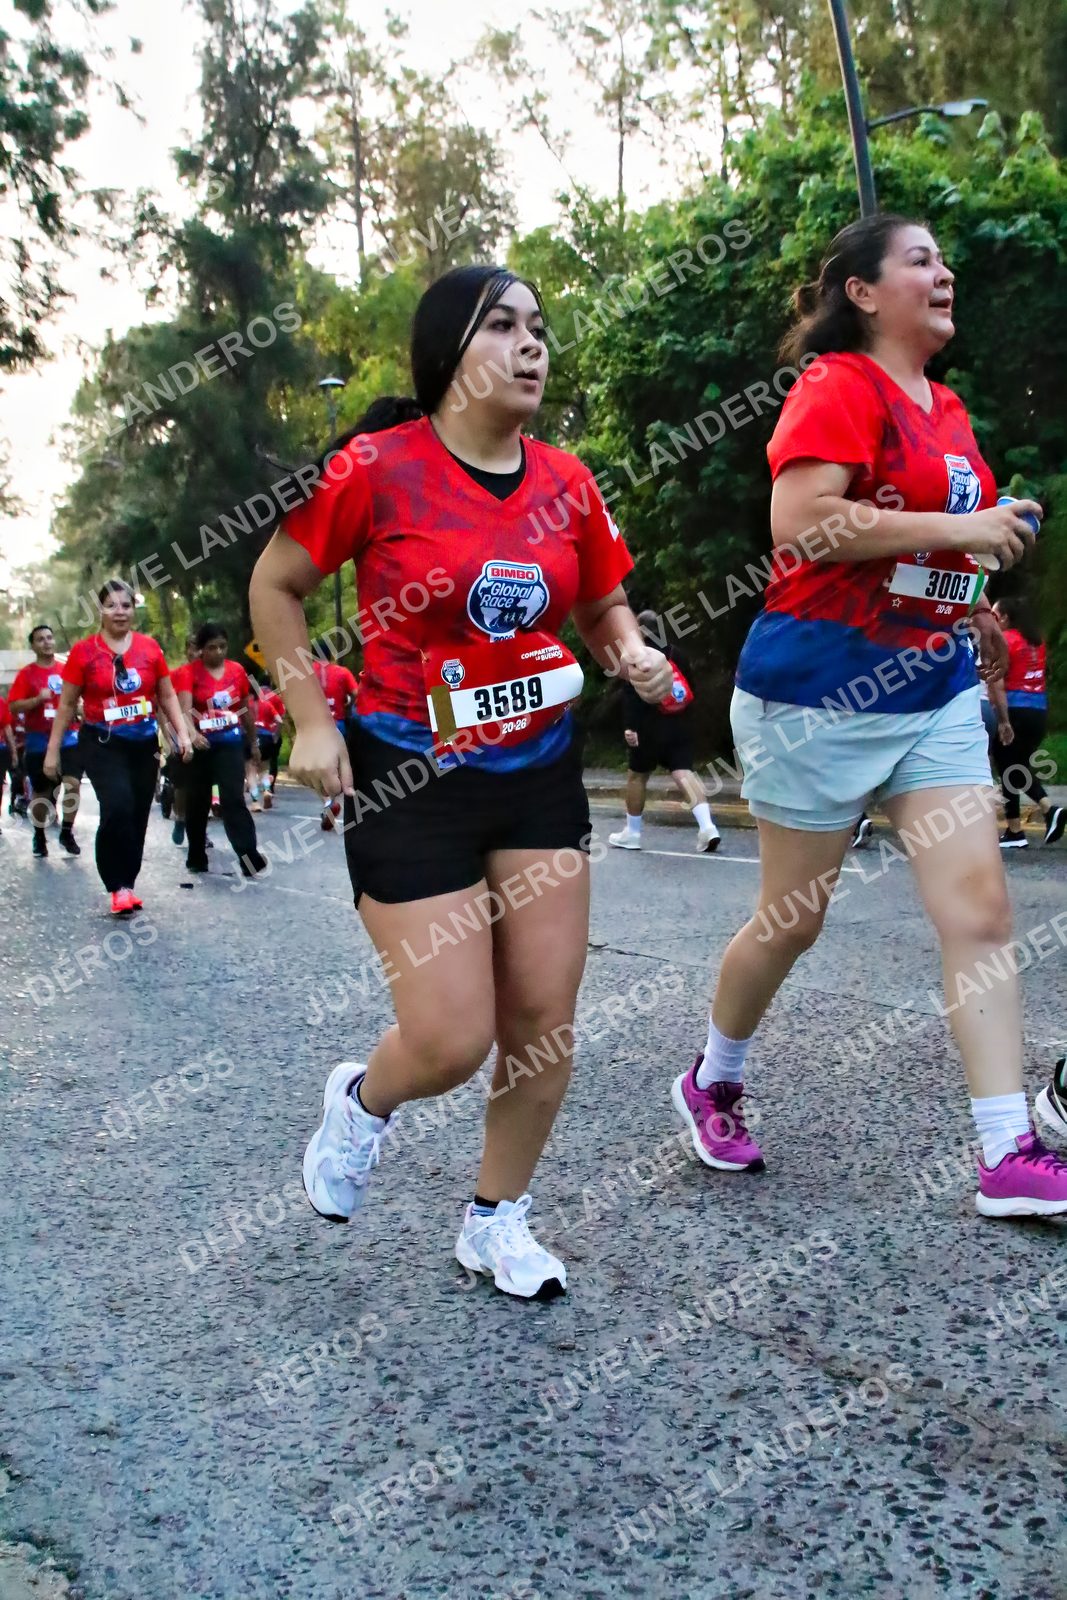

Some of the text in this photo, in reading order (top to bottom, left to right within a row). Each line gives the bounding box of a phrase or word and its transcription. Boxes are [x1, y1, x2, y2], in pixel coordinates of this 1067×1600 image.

[490, 568, 535, 580] BIMBO
[490, 583, 533, 599] Global
[925, 570, 971, 601] 3003
[480, 594, 514, 608] Race
[474, 676, 543, 721] 3589
